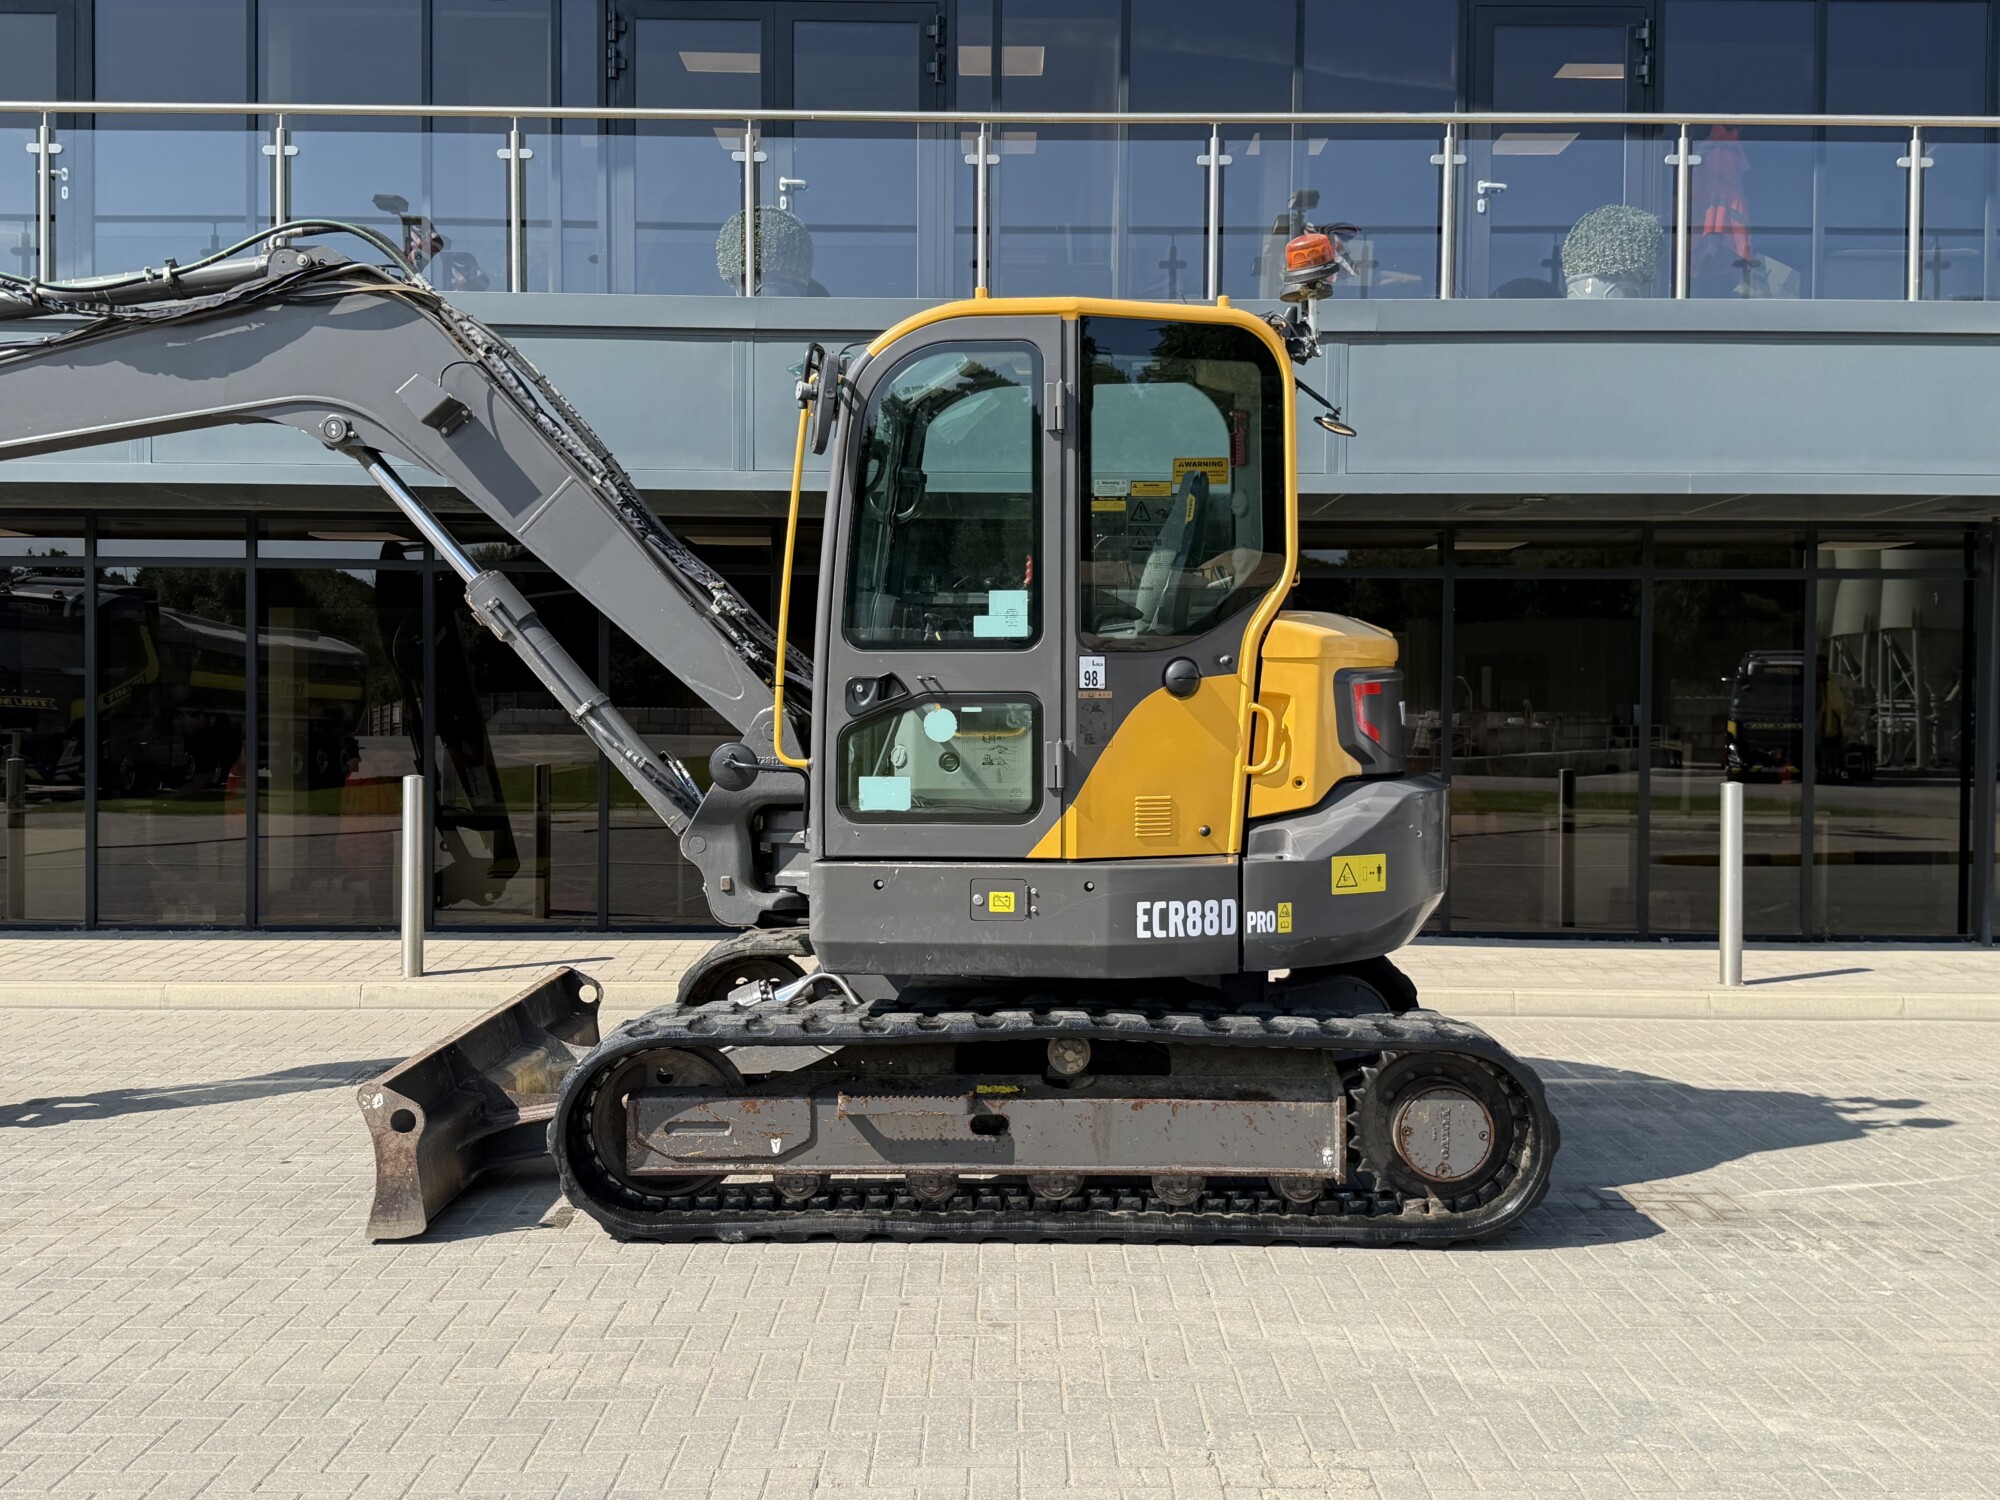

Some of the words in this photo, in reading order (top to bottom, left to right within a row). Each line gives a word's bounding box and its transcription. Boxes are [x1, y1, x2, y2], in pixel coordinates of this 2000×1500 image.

[1184, 460, 1223, 468] WARNING
[1083, 670, 1098, 687] 98
[1136, 898, 1237, 938] ECR88D
[1246, 910, 1276, 934] PRO
[1441, 1108, 1451, 1161] VOLVO
